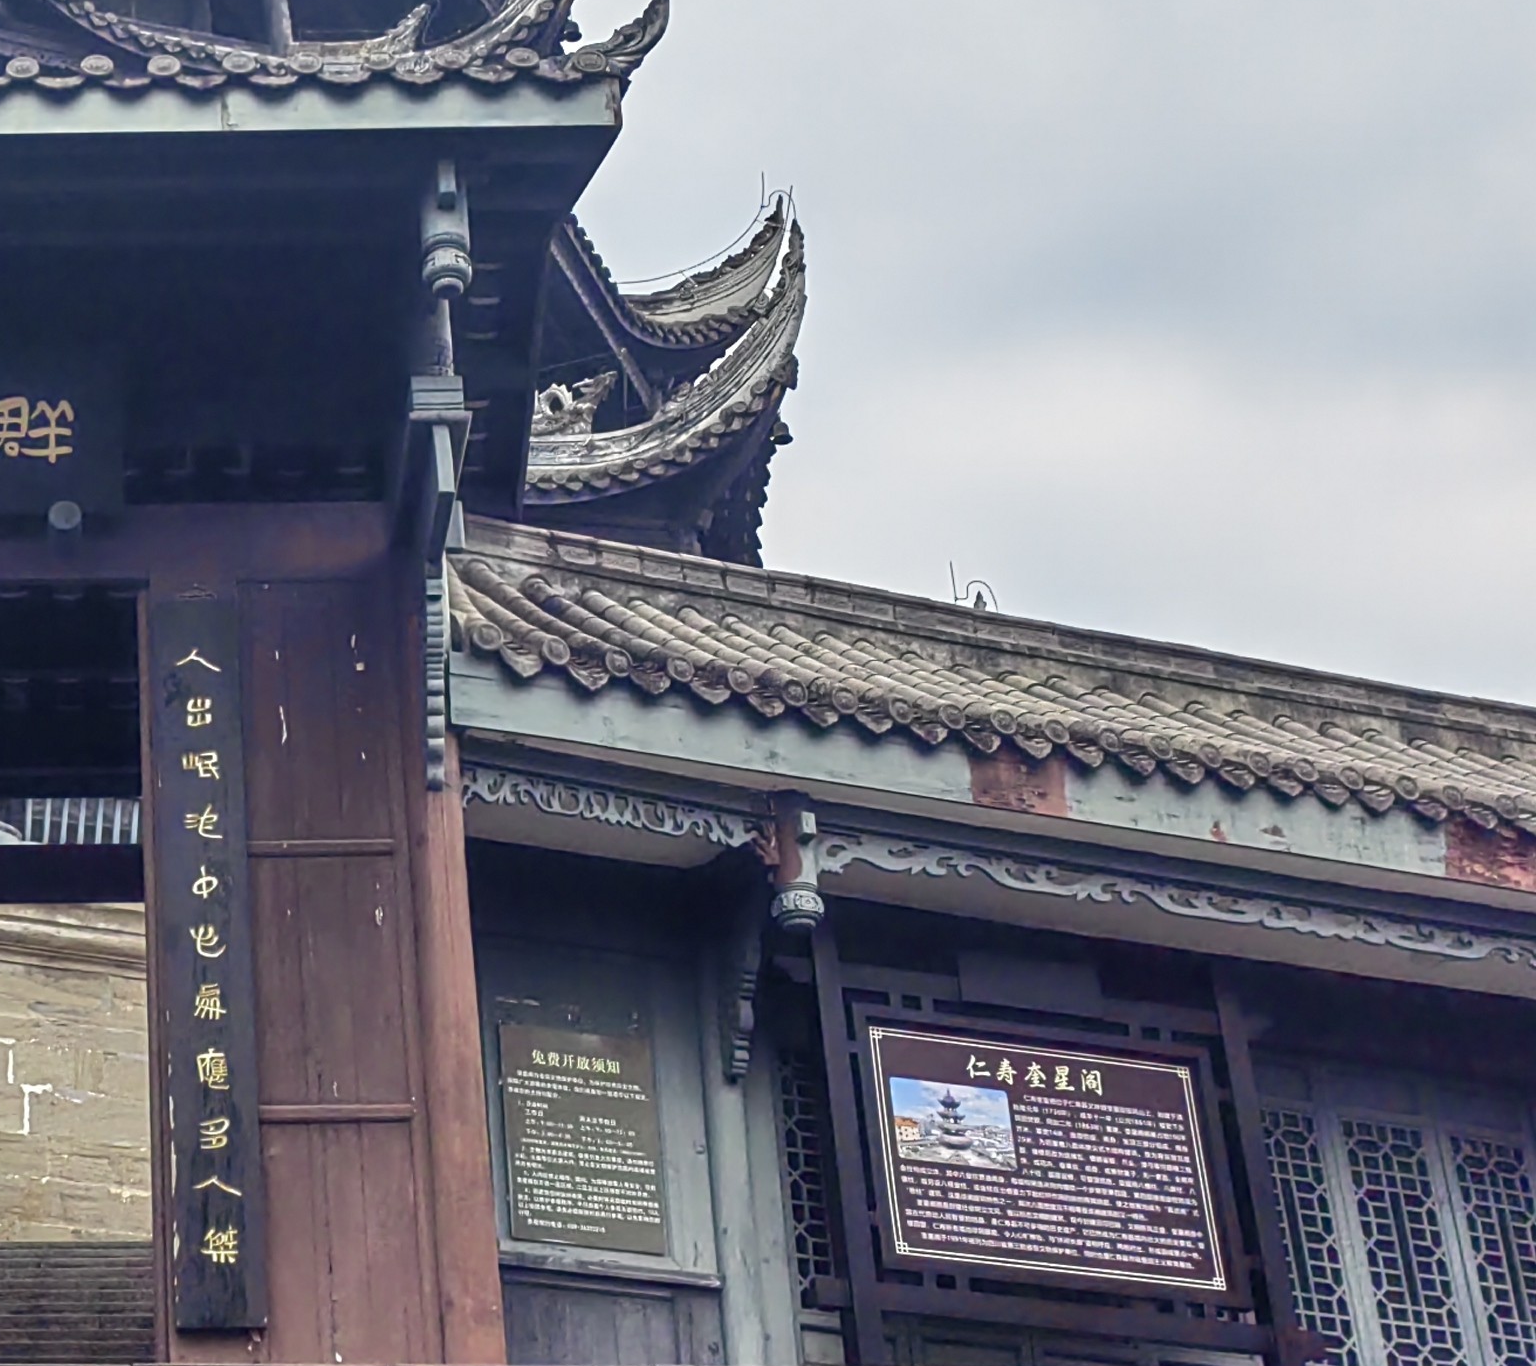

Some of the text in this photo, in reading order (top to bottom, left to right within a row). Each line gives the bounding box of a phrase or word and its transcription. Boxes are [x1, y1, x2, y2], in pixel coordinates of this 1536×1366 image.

[531, 1049, 621, 1075] 免费开放须知
[966, 1055, 1104, 1096] 仁寿奎星阁
